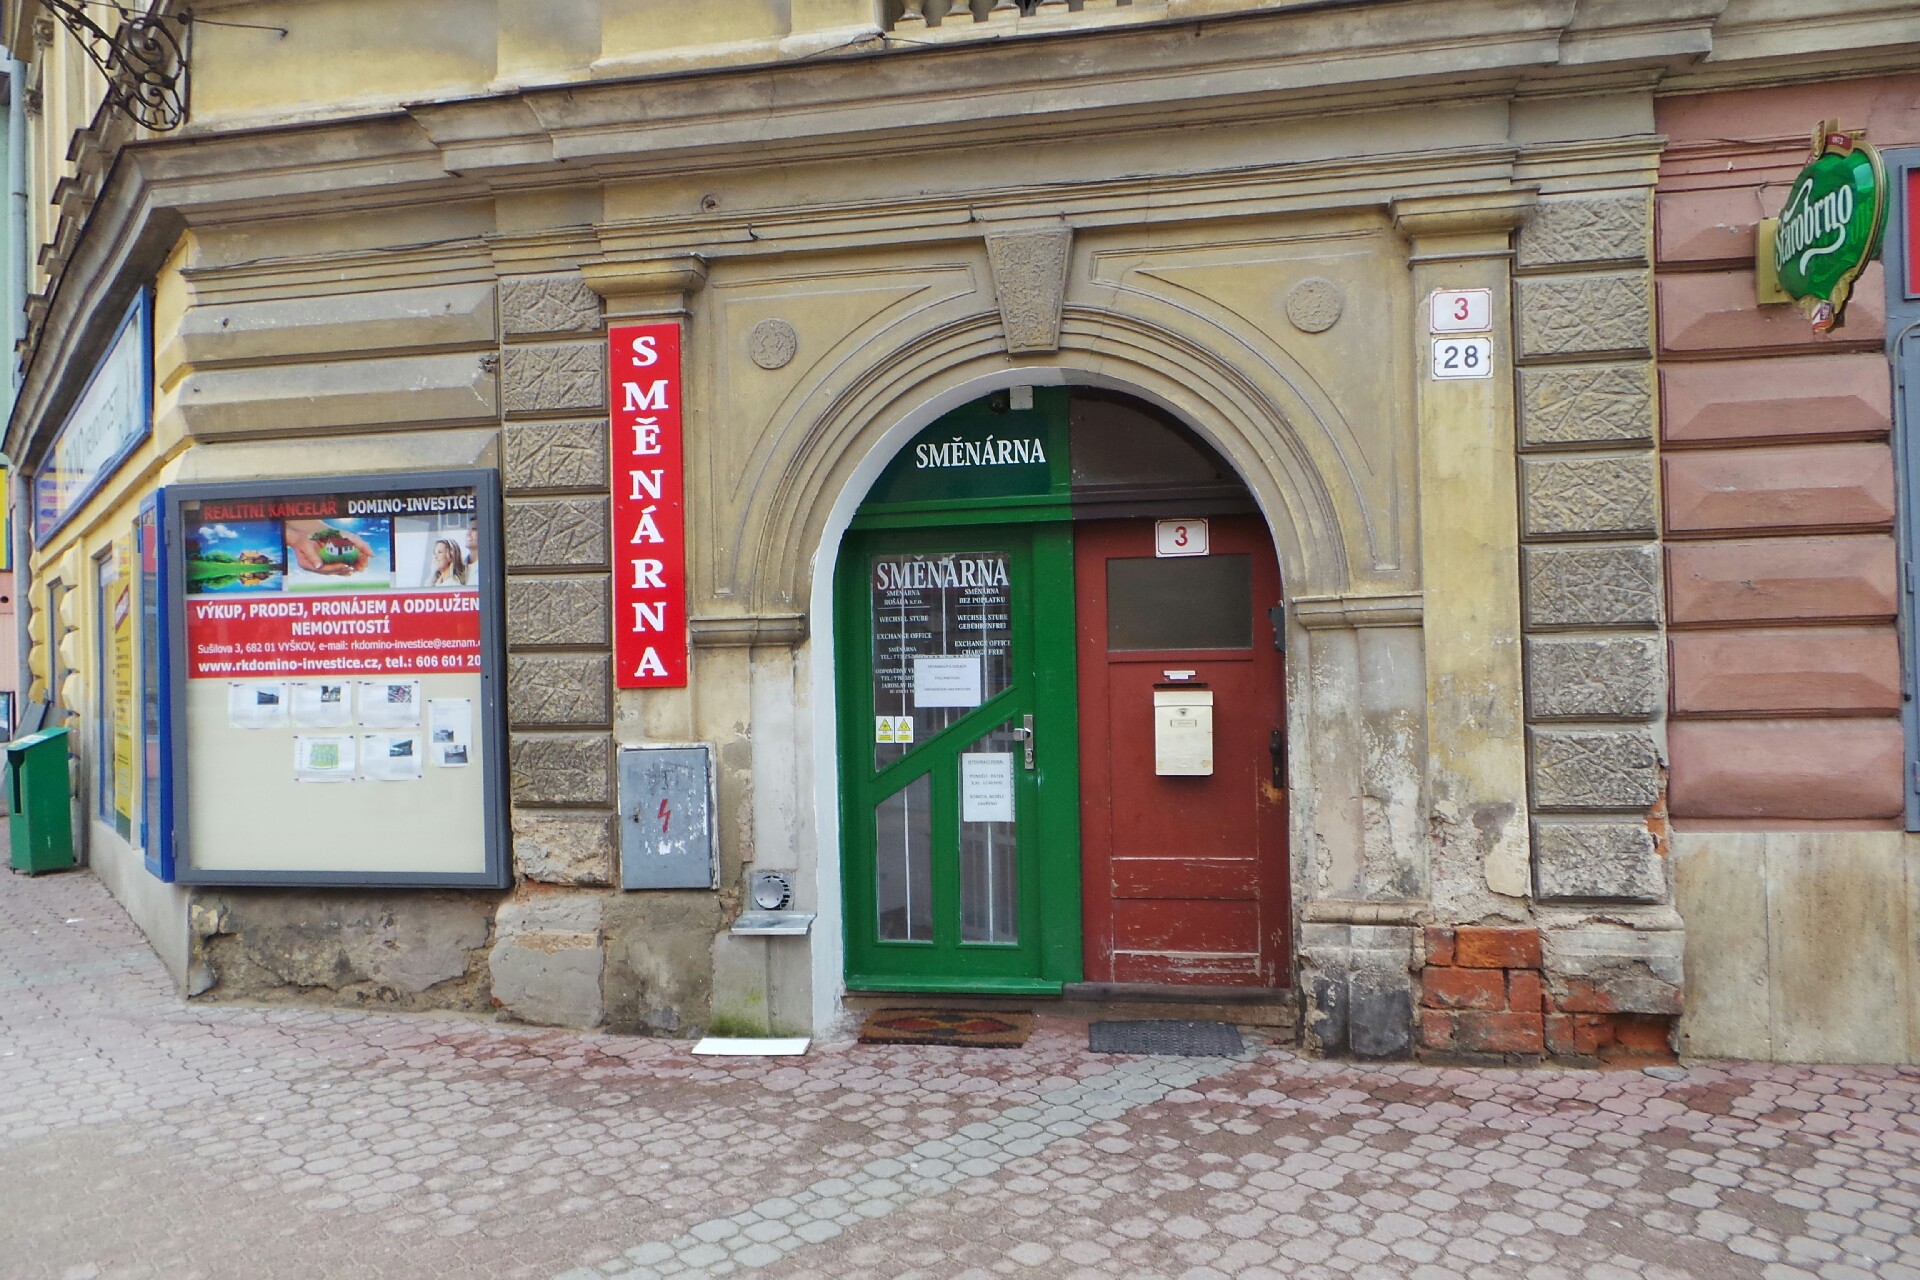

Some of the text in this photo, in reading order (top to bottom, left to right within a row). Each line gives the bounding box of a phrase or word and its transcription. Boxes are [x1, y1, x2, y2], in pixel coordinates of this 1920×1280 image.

[1775, 178, 1853, 276] Starobrno
[1454, 297, 1469, 320] 3
[1444, 345, 1478, 368] 28
[916, 434, 1046, 468] SMĚNÁRNA
[348, 495, 474, 514] DOMINO-INVESTICE
[621, 336, 669, 678] SMĚNÁRNA
[1174, 526, 1188, 546] 3
[876, 554, 1010, 590] SMĚNÁRNA
[196, 602, 246, 620] VÝKUP,
[250, 602, 308, 618] PRODEJ,
[312, 597, 386, 616] PRONÁJEM
[390, 602, 400, 614] A
[292, 616, 390, 636] NEMOVITOSTÍ
[198, 644, 232, 654] Sušilova
[235, 644, 244, 654] 3,
[246, 643, 262, 652] 682
[264, 642, 276, 652] 01
[278, 640, 316, 652] VYŠKOV,
[318, 640, 348, 650] e-mail:
[198, 656, 382, 672] www.rkdomino-investice.cz,
[386, 656, 412, 668] tel.:
[416, 656, 438, 668] 606
[442, 656, 462, 667] 601
